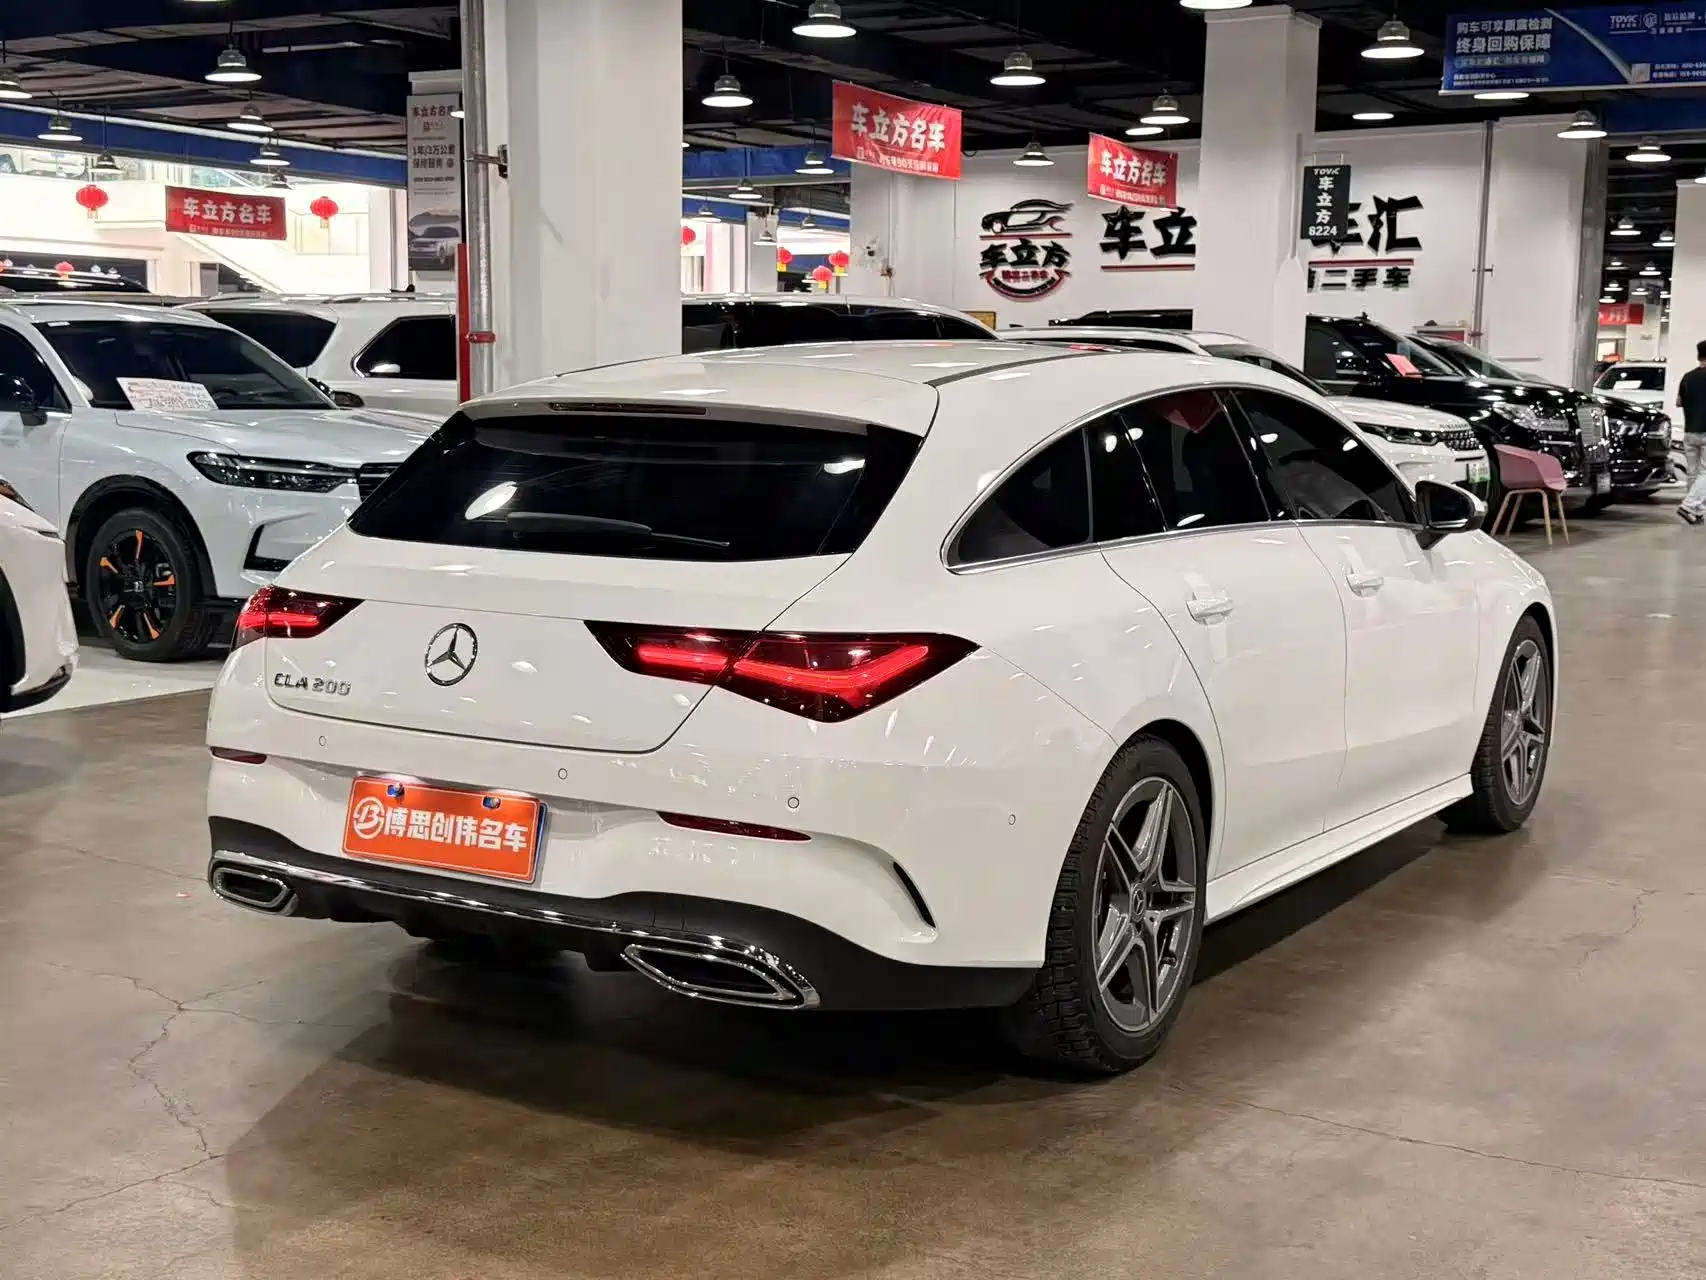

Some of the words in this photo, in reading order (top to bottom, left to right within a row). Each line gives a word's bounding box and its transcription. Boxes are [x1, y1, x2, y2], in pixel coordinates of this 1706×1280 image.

[1456, 34, 1551, 53] 终身回购保障
[850, 103, 945, 152] 车立方名车
[1100, 150, 1167, 186] 车立方名车
[183, 197, 272, 224] 车立方名车
[1316, 176, 1334, 224] 车立方
[1099, 205, 1197, 260] 车立
[1308, 226, 1338, 236] 8224
[980, 238, 1071, 268] 车立方
[275, 673, 308, 690] CLA
[312, 678, 352, 696] 200
[384, 806, 529, 852] 博思创伟名车
